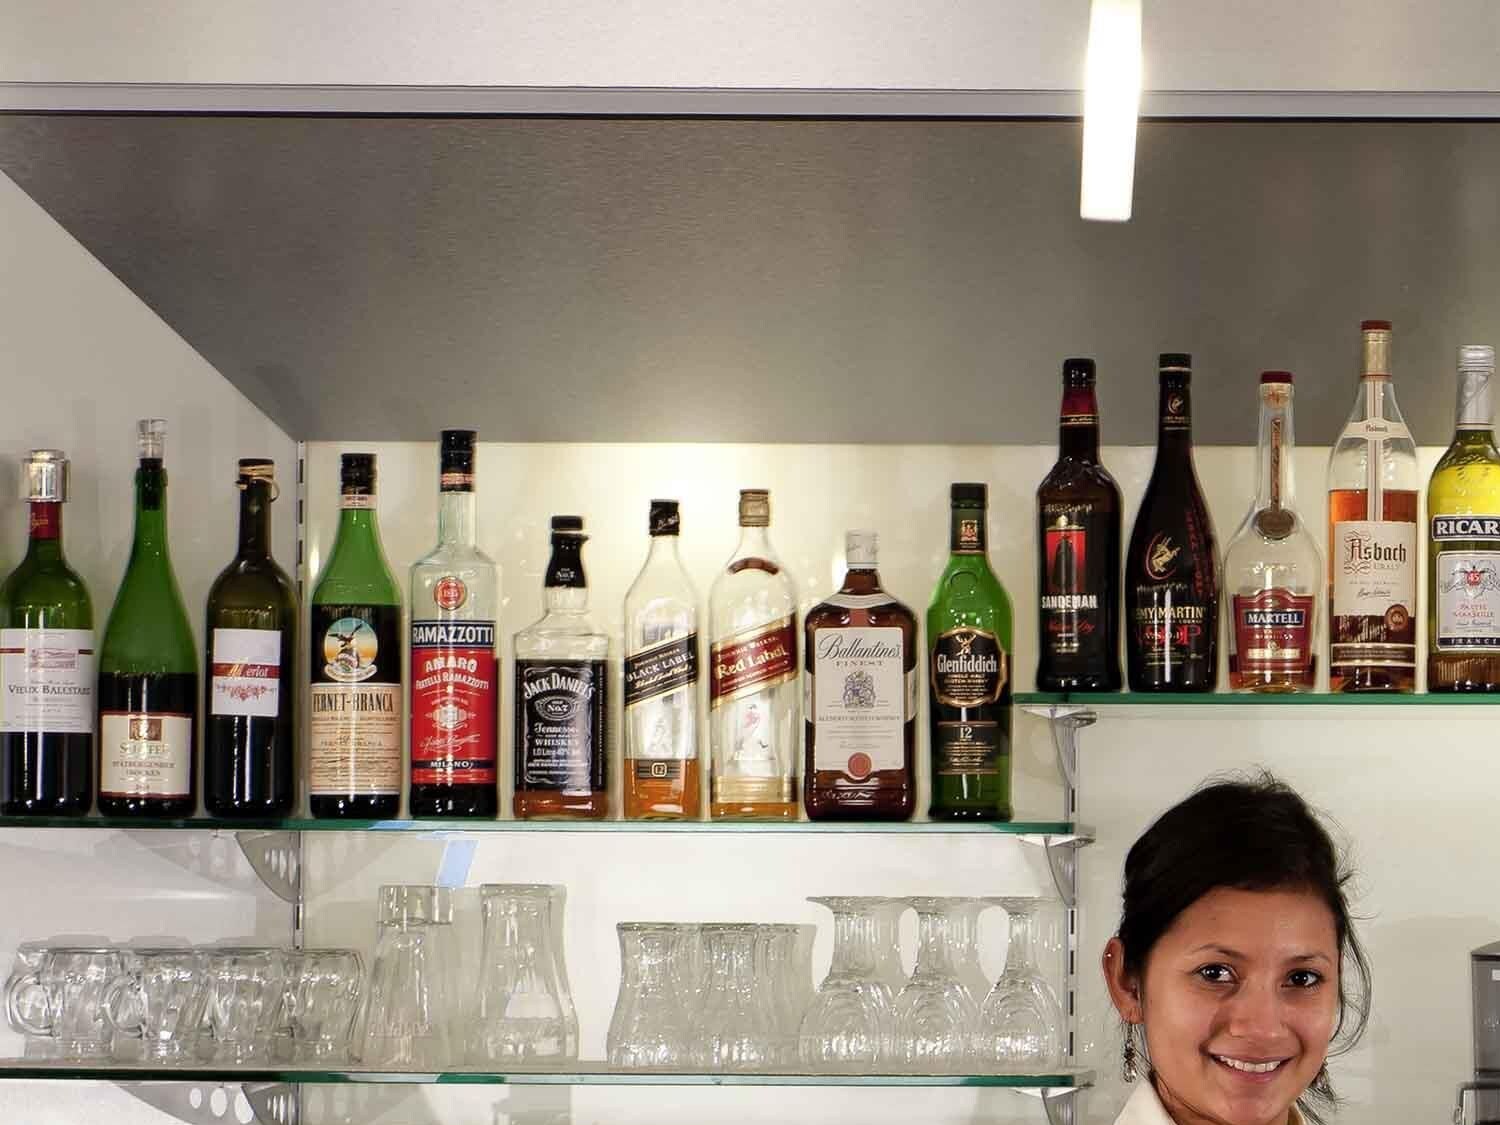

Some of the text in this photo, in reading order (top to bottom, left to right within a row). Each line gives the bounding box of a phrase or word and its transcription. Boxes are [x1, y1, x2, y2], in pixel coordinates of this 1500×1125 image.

[1350, 538, 1407, 563] Asbach
[1042, 595, 1098, 609] SANDEMAN
[1158, 606, 1204, 619] MARTIN
[1247, 613, 1300, 624] MARTELL
[413, 626, 493, 643] RAMAZZOTTI
[425, 656, 478, 673] AMARO
[662, 650, 695, 669] LABEL
[717, 658, 746, 679] Red
[747, 643, 789, 668] Label
[937, 654, 997, 673] Glenfiddich
[523, 672, 596, 700] JACK DANIEL'S
[960, 727, 973, 739] 12
[430, 761, 470, 769] MILANO
